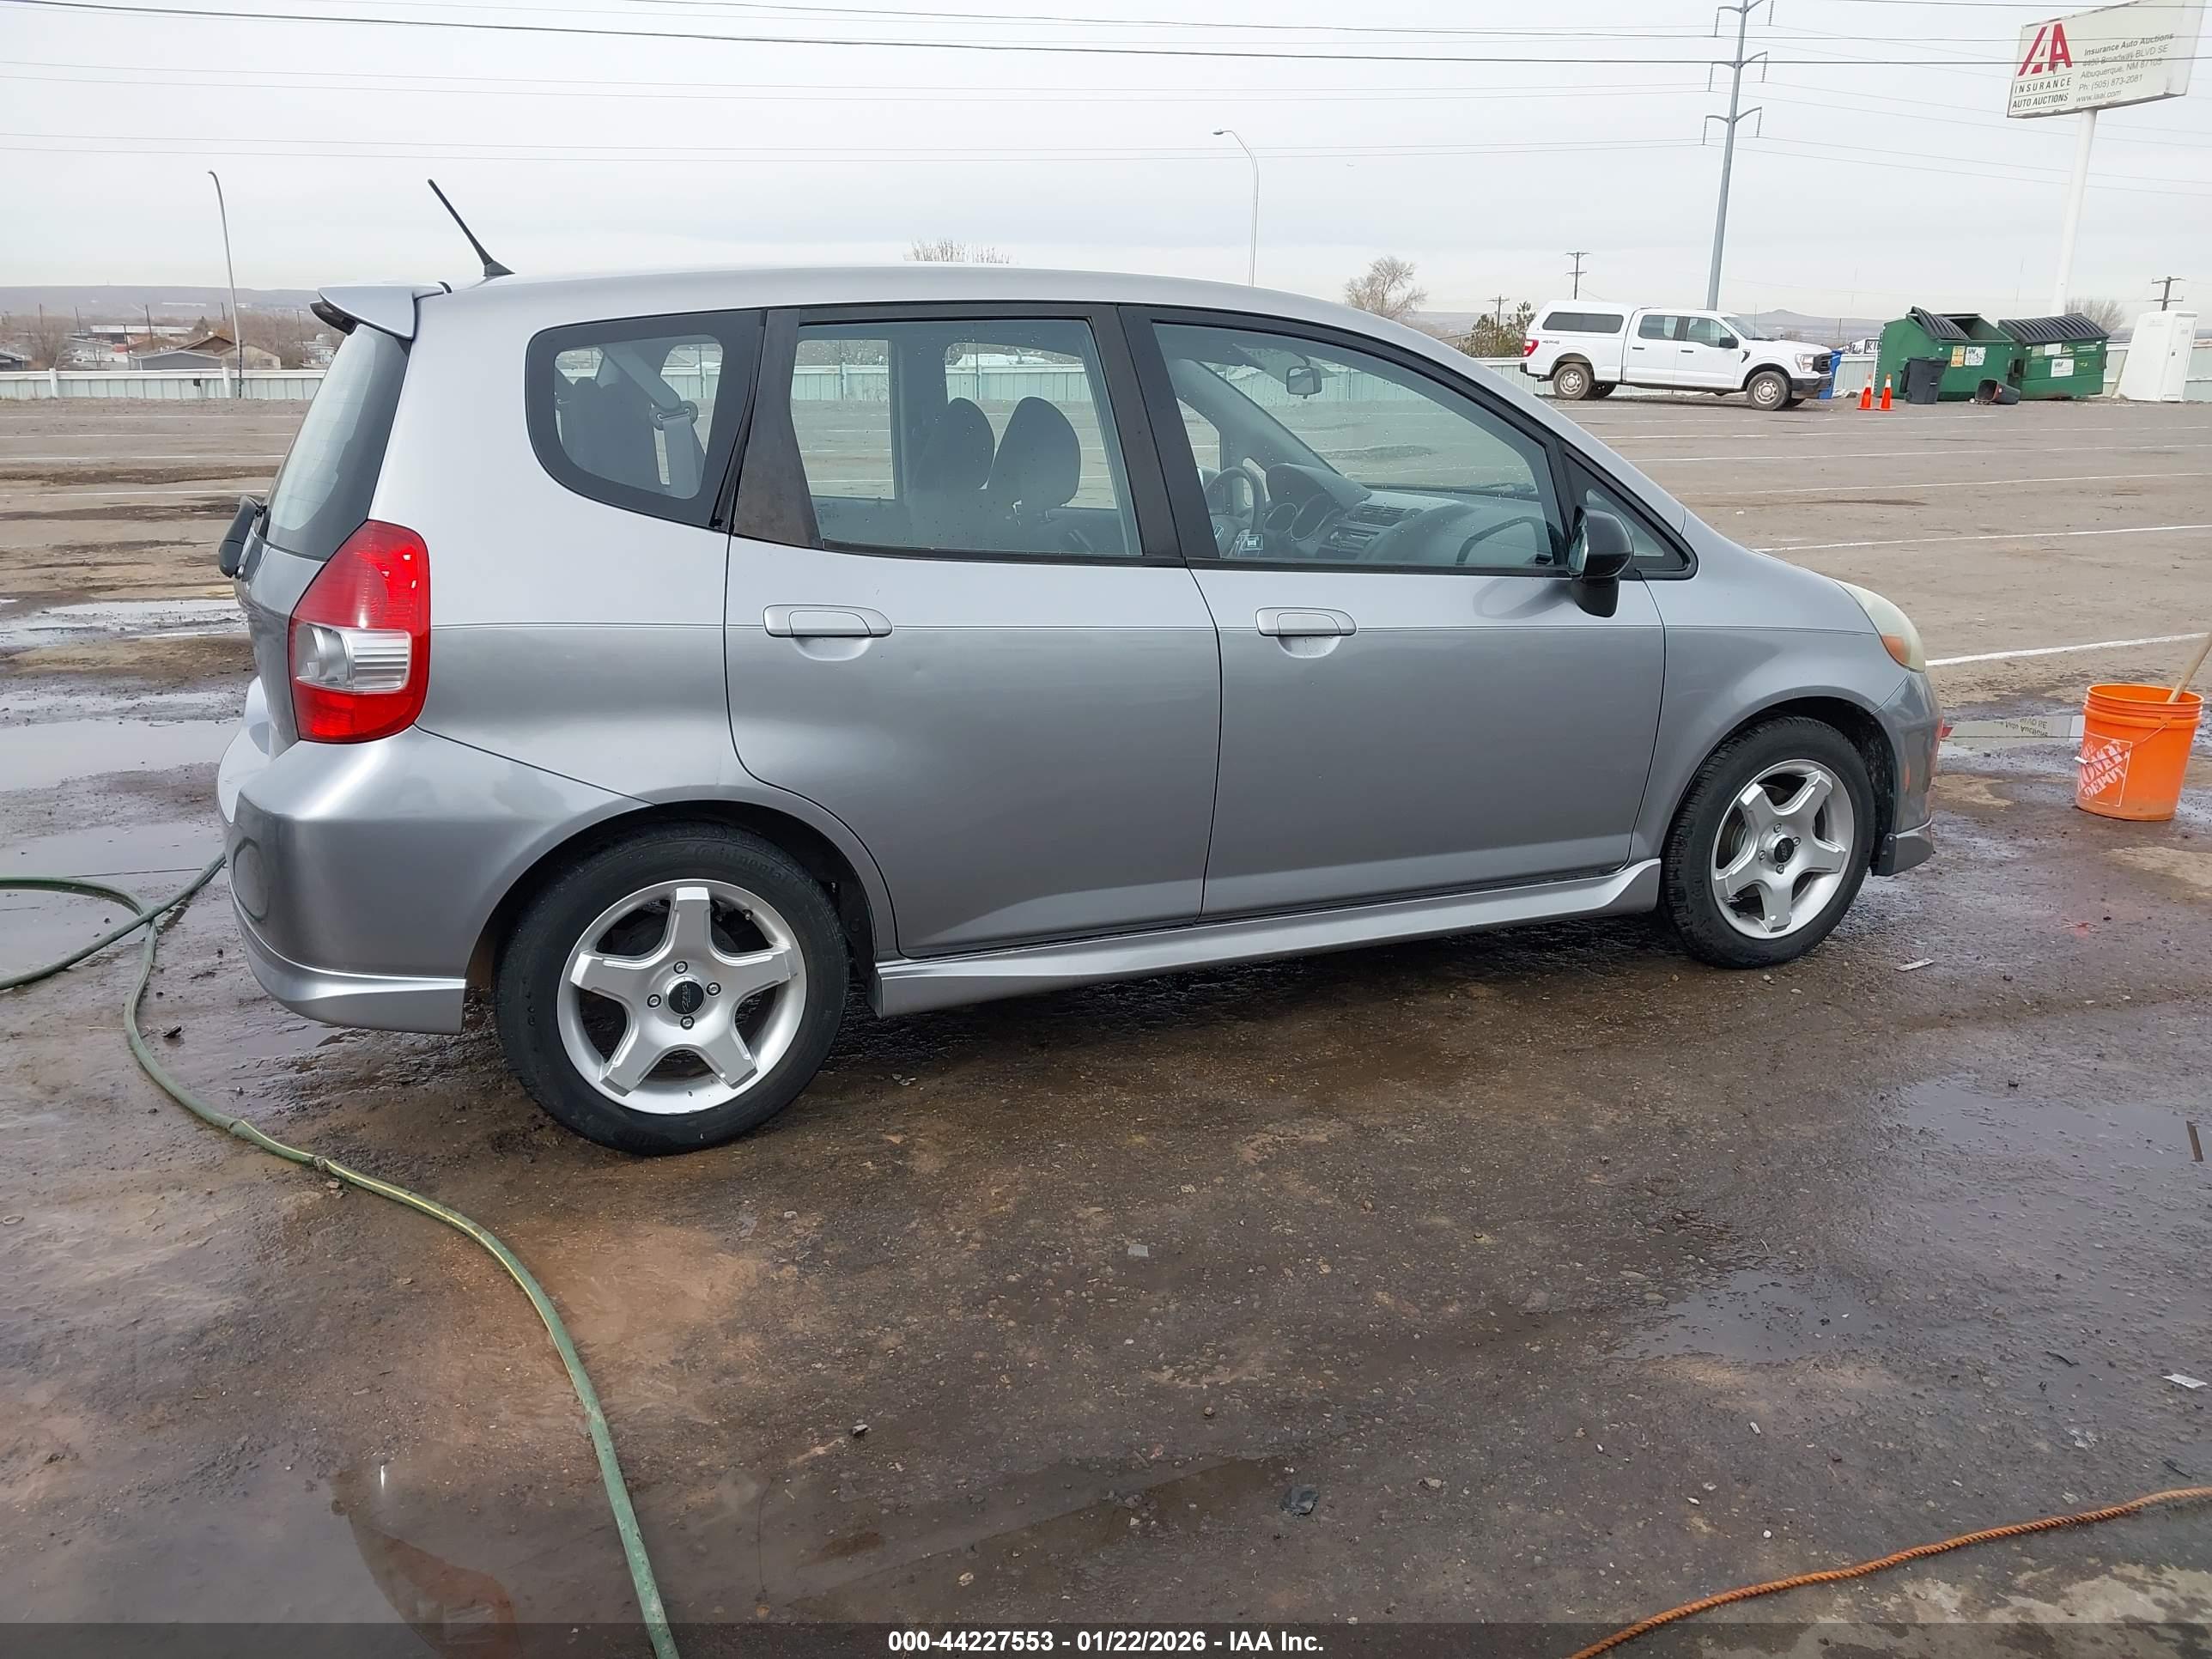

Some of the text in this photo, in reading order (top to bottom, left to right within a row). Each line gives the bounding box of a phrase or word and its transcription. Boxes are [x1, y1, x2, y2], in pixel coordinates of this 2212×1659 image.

[2084, 33, 2174, 56] Insurance Auto Auctions
[2136, 47, 2156, 58] BLVD
[2158, 44, 2169, 52] SE
[2126, 61, 2139, 70] NM
[2014, 77, 2071, 94] INSURANCE
[2012, 93, 2069, 108] AUTO AUCTIONS
[2082, 766, 2124, 798] DEPOT
